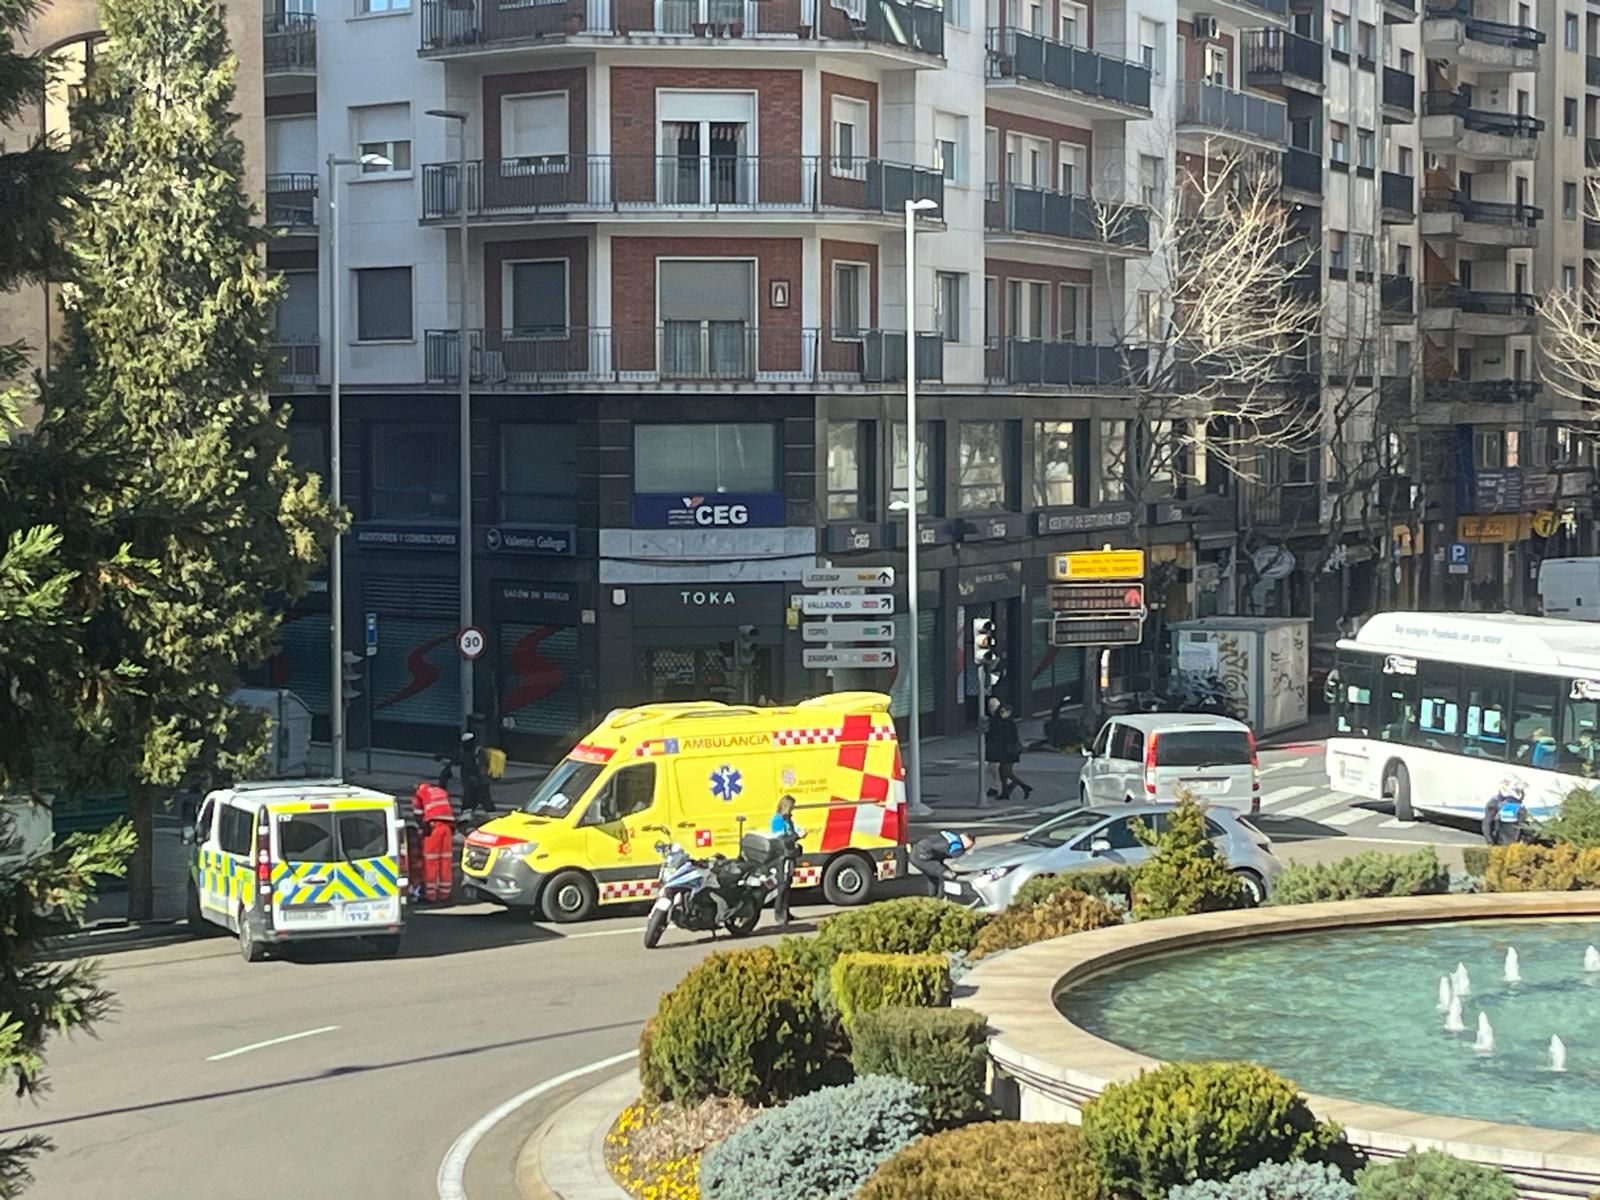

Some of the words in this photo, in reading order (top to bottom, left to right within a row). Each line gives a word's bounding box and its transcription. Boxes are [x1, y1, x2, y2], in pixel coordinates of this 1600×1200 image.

[696, 505, 747, 525] CEG
[537, 535, 567, 552] Gallego
[680, 591, 736, 605] TOKA
[464, 636, 480, 648] 30
[683, 735, 770, 750] AMBULANCIA
